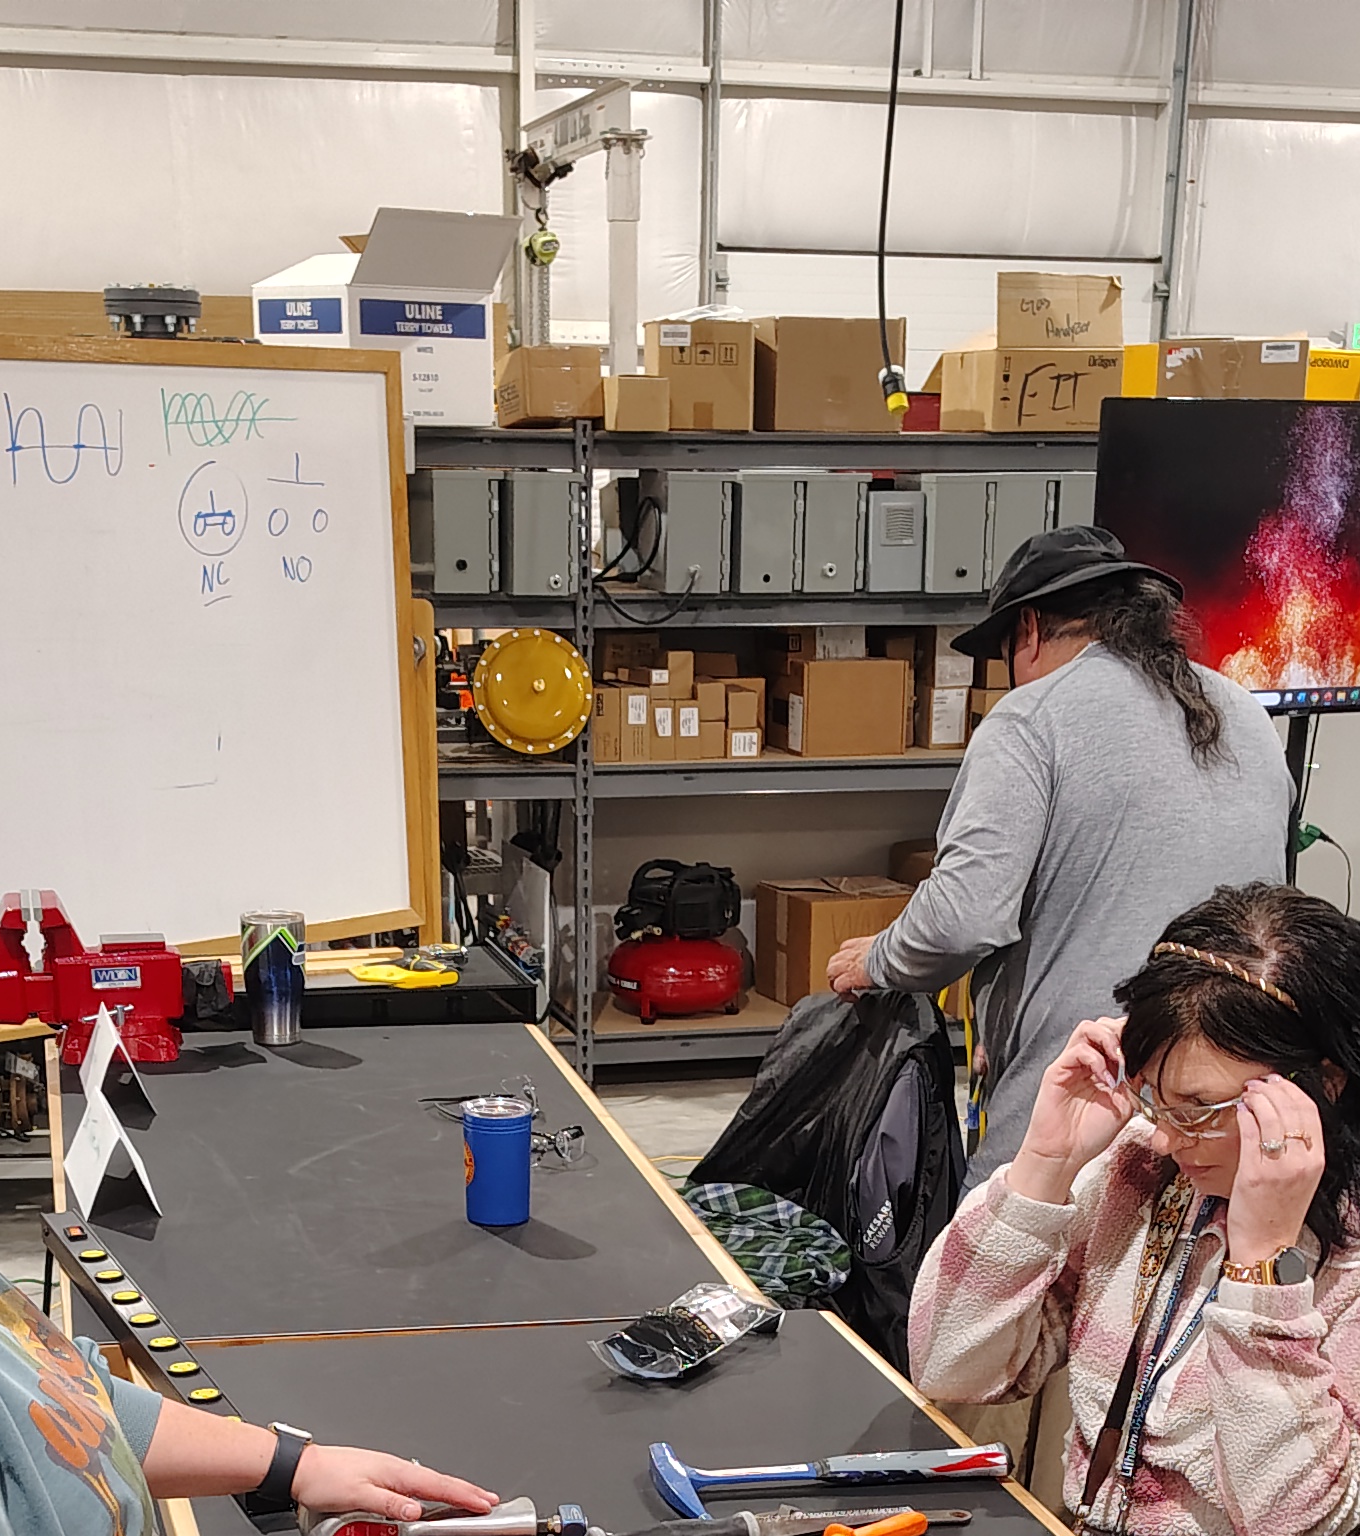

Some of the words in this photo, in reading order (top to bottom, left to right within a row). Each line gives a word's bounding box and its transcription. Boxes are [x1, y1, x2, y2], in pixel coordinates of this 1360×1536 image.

[285, 301, 312, 317] ULINE
[404, 303, 443, 320] ULINE
[396, 321, 418, 333] TERRY
[421, 323, 453, 335] TOWELS
[201, 561, 230, 594] NC
[282, 555, 312, 583] NO
[1121, 1430, 1139, 1479] Lithium
